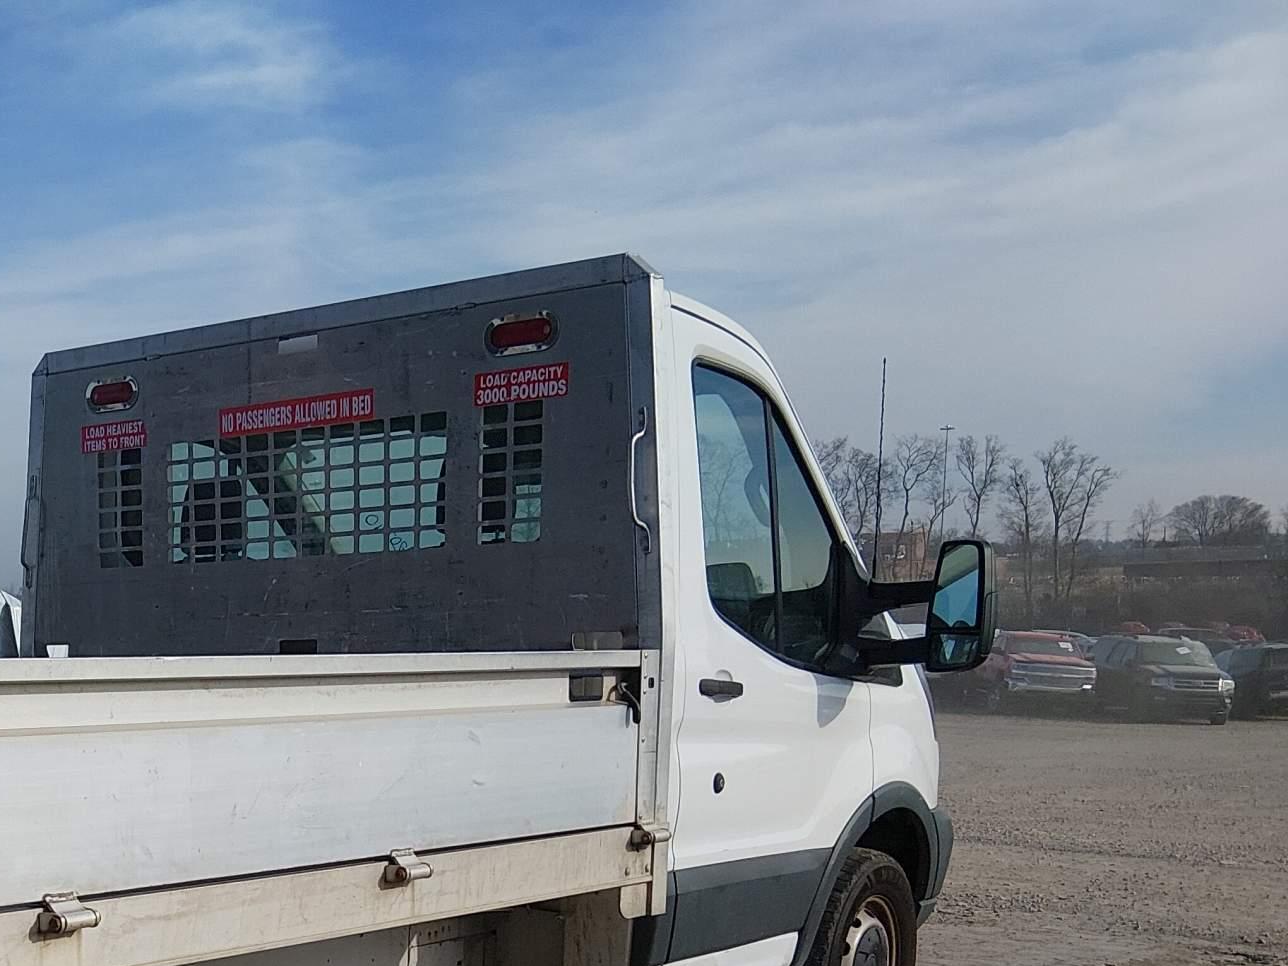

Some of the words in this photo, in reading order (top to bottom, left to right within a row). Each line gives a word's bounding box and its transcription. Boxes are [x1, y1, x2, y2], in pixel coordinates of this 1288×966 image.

[480, 374, 508, 388] LOAD
[511, 366, 563, 384] CAPACITY
[476, 387, 507, 404] 3000
[511, 379, 567, 400] POUNDS
[222, 414, 233, 432] NO
[236, 405, 293, 431] PASSENGERS
[294, 399, 337, 423] ALLOWED
[340, 397, 350, 416] IN
[352, 395, 371, 416] BED
[85, 426, 105, 439] LOAD
[106, 421, 143, 436] HEAVIEST
[84, 439, 106, 452] ITEMS
[108, 437, 118, 449] TO
[119, 434, 145, 449] FRONT
